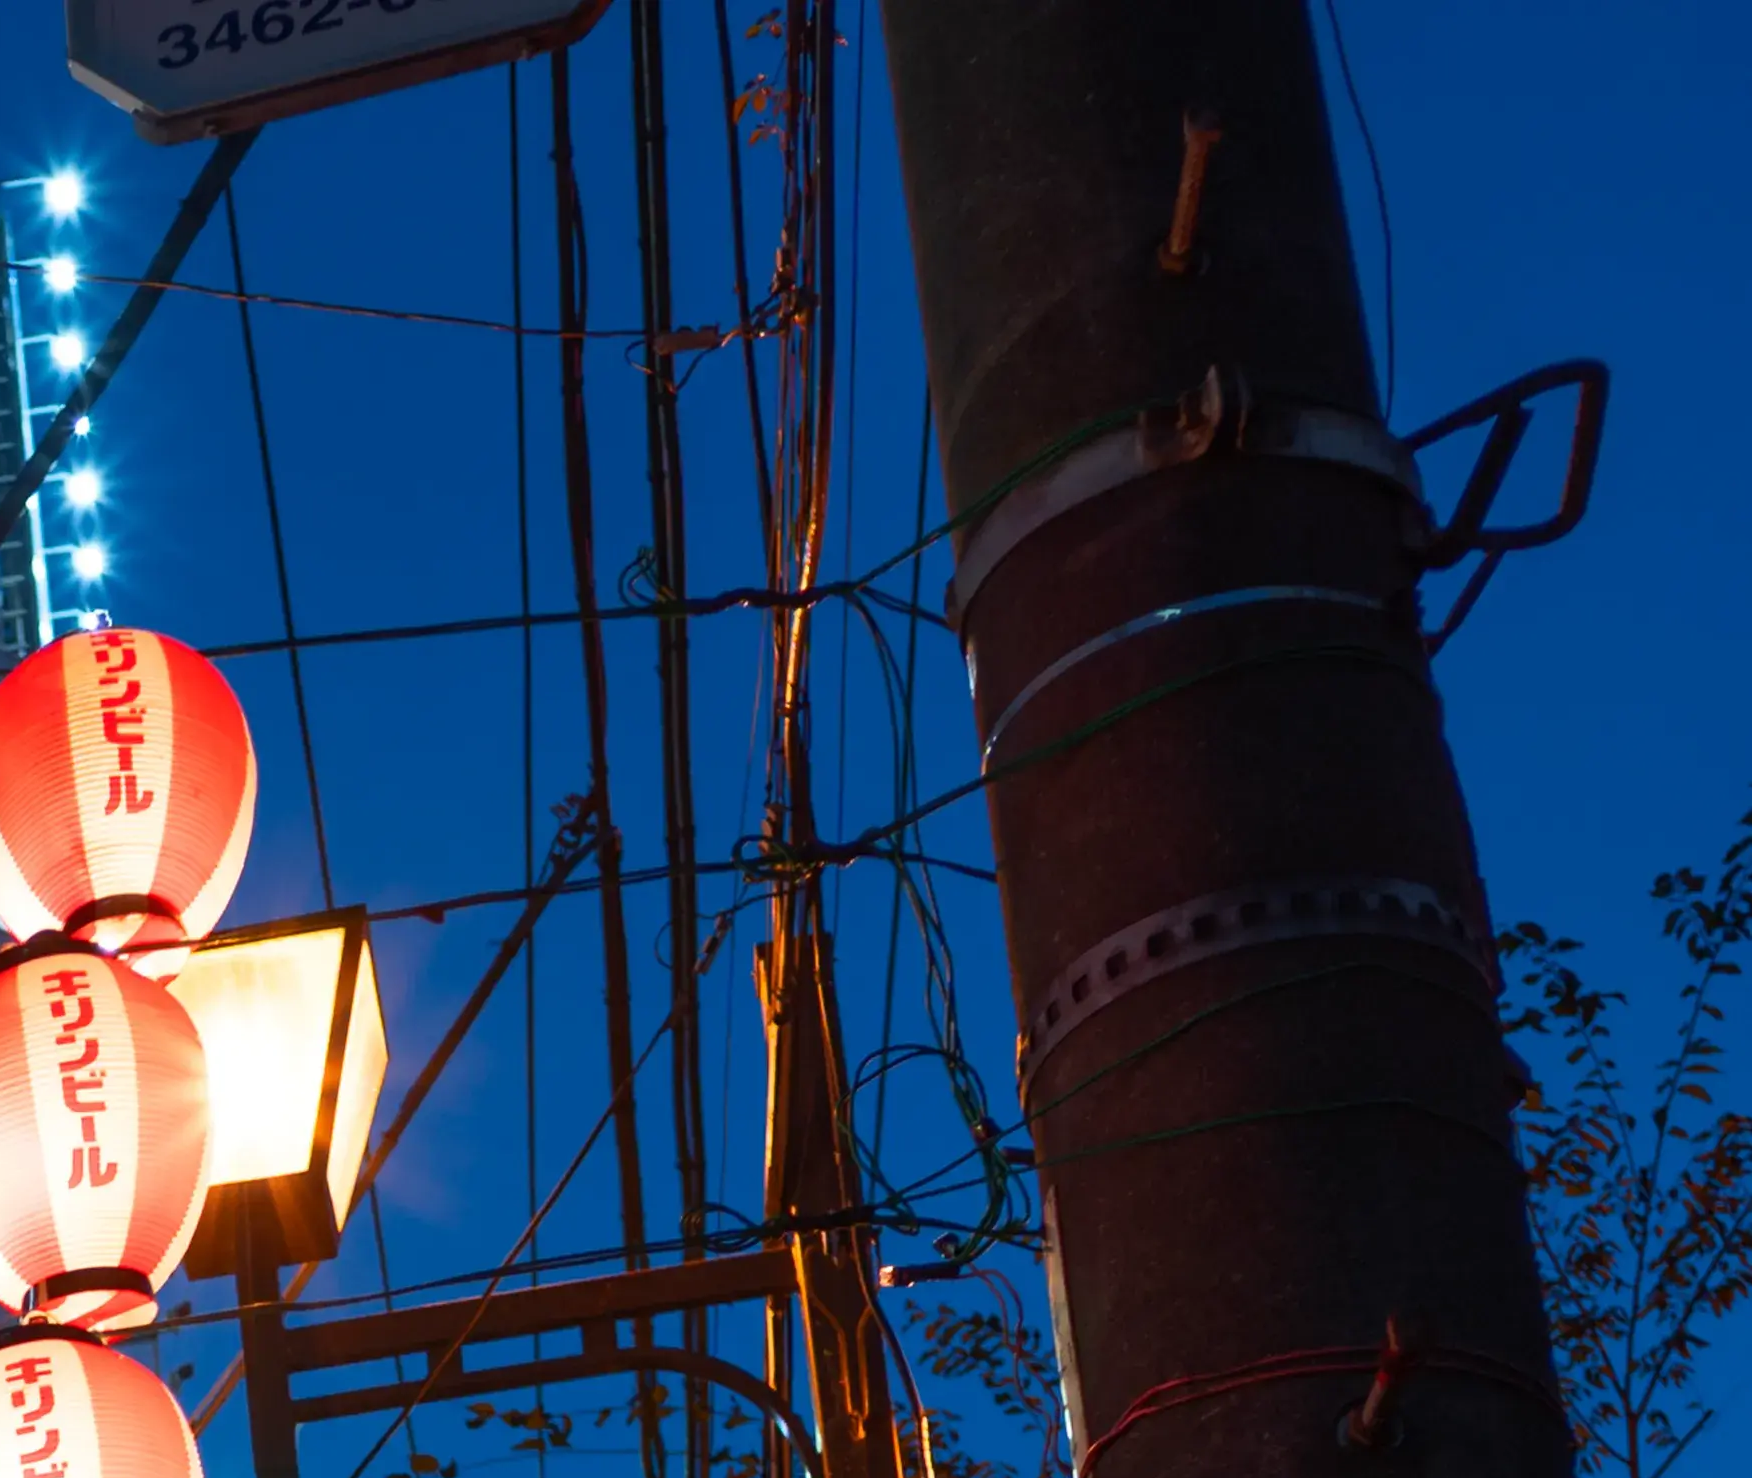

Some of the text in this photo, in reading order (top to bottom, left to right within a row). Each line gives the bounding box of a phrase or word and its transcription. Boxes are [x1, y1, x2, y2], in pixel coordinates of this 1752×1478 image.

[157, 0, 417, 69] 3462-
[89, 630, 155, 817] キリンビール
[41, 968, 119, 1191] キリンビール
